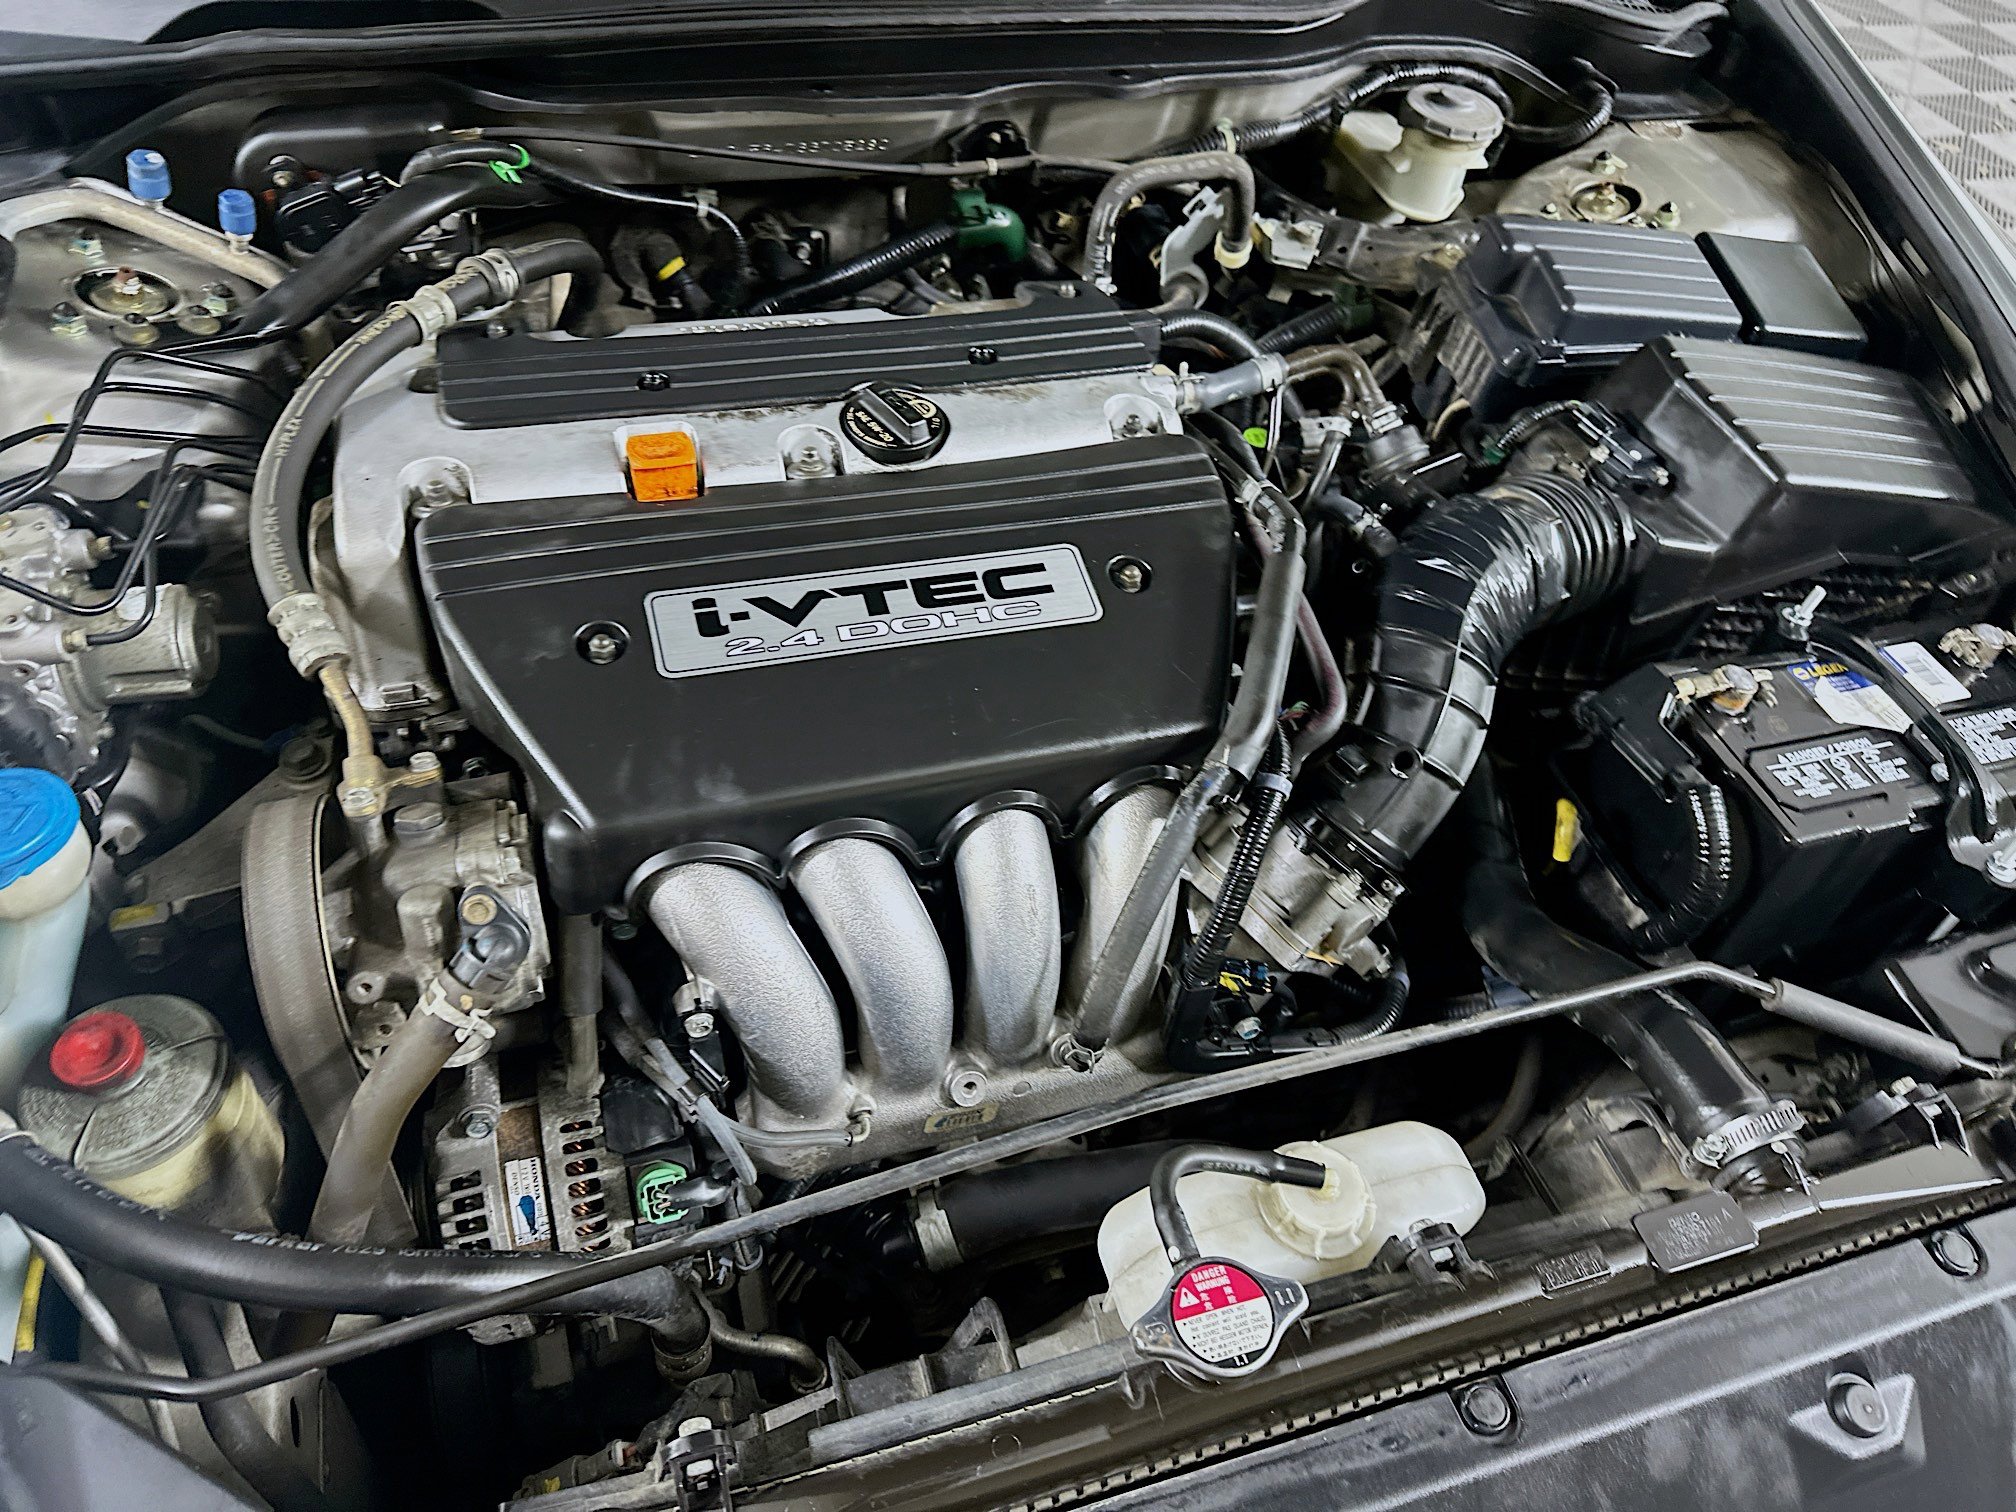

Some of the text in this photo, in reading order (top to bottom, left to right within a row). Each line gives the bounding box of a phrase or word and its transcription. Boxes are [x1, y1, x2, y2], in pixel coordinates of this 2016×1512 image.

[691, 562, 1056, 638] i-VTEC
[725, 600, 1043, 657] 2.4 DOHC
[530, 1159, 540, 1200] HONDA
[1191, 1266, 1226, 1282] DANGER
[1194, 1276, 1231, 1292] WARNING
[1274, 1288, 1296, 1306] 1.1
[1233, 1353, 1249, 1367] 1.1
